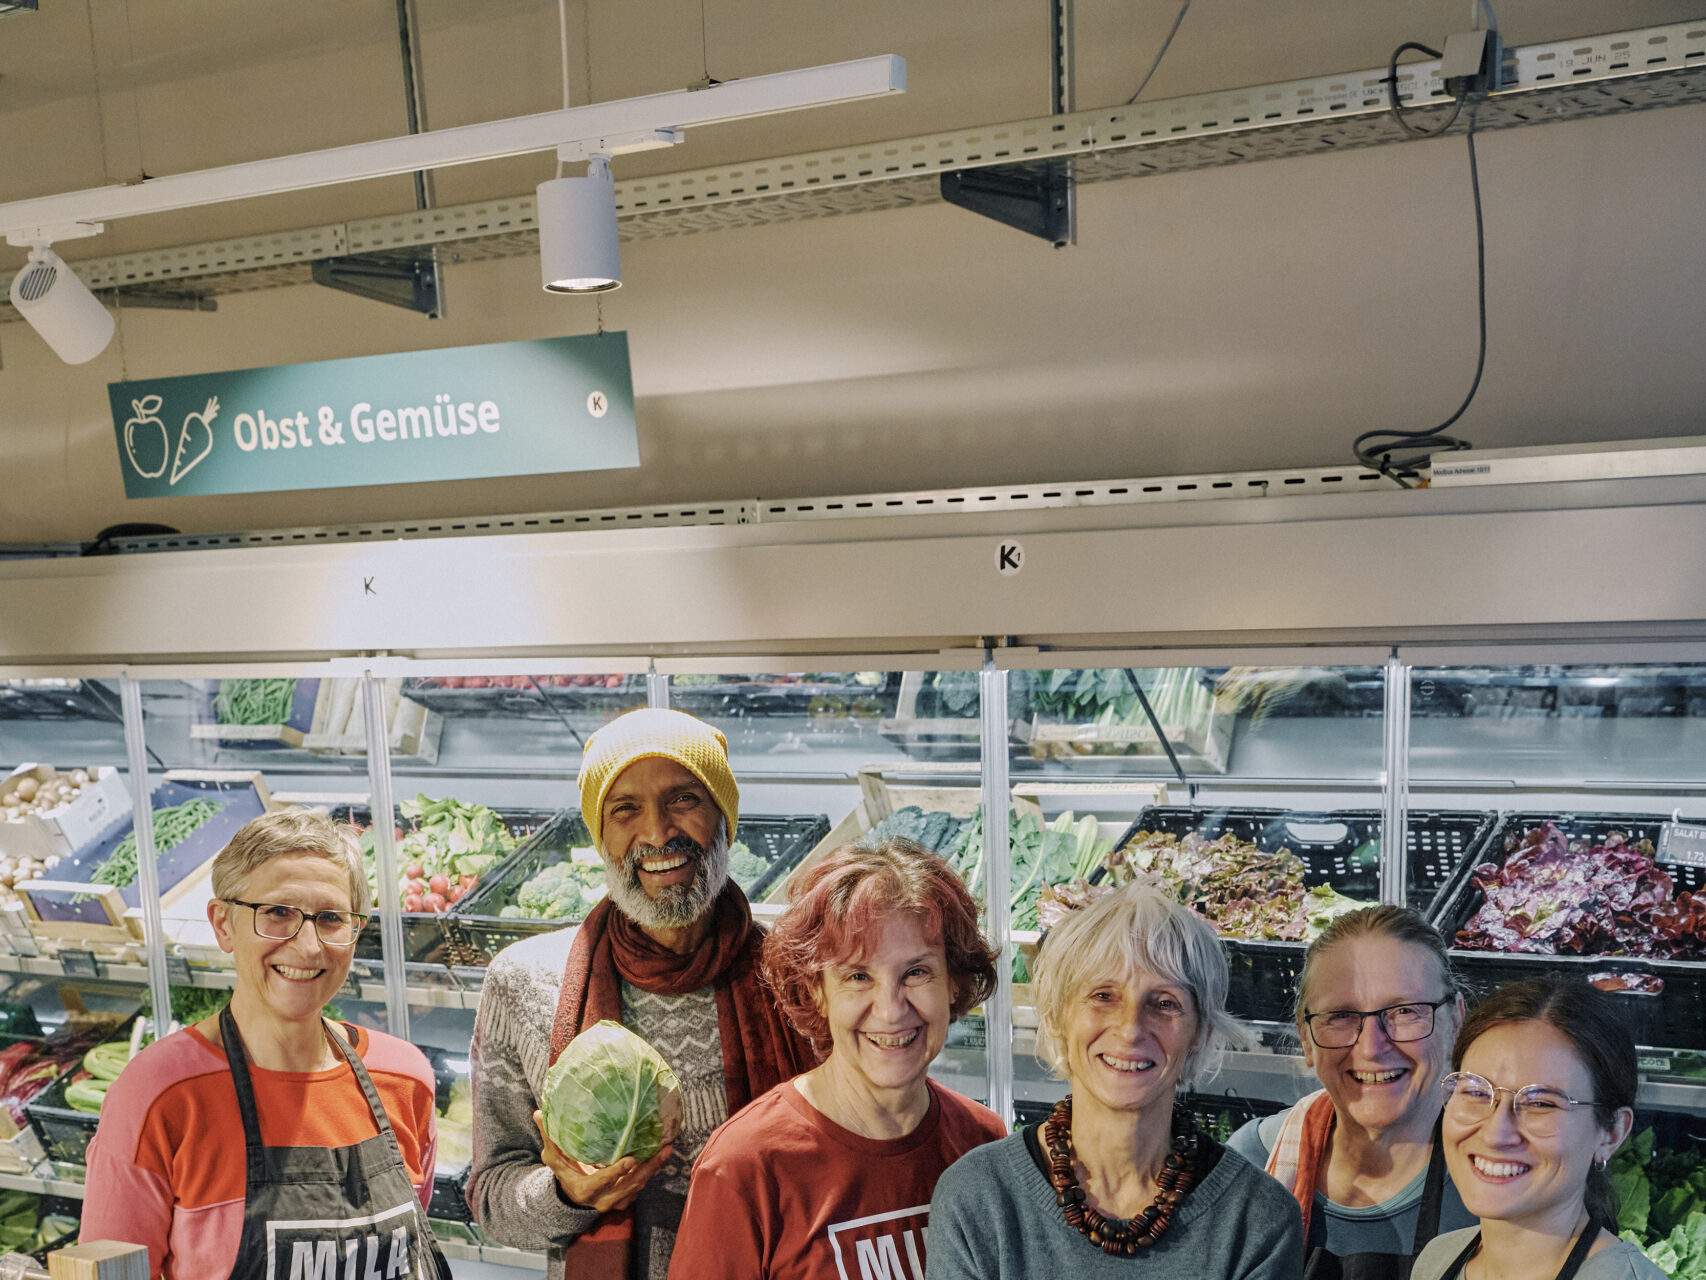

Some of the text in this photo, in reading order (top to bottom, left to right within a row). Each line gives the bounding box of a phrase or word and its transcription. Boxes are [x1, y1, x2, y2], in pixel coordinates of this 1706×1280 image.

[592, 395, 603, 411] K
[233, 393, 500, 452] Obst & Gemüse
[363, 575, 377, 596] K
[1674, 828, 1700, 839] SALAT
